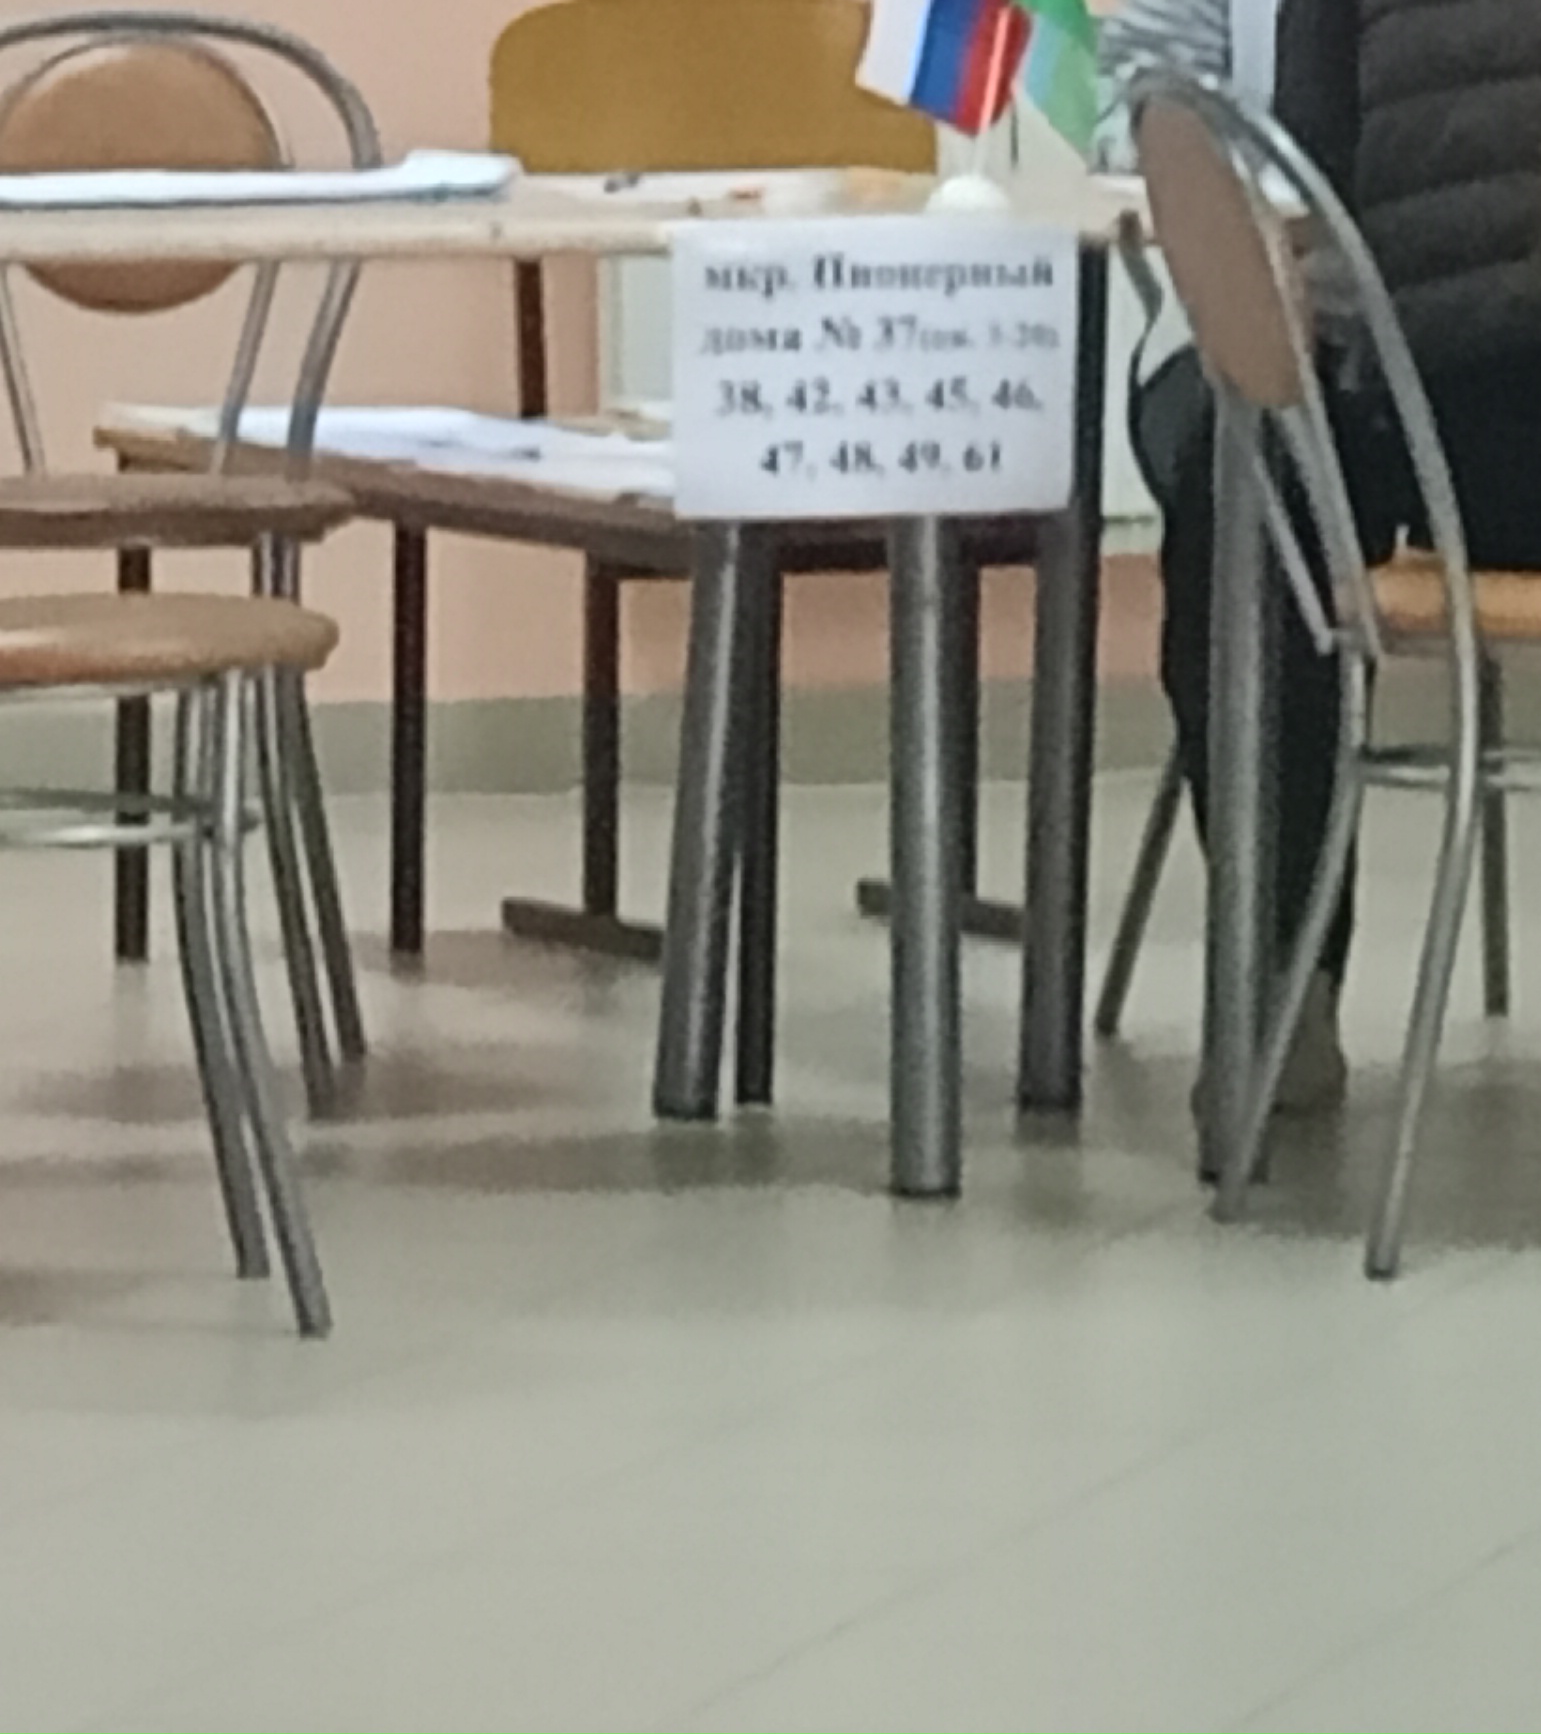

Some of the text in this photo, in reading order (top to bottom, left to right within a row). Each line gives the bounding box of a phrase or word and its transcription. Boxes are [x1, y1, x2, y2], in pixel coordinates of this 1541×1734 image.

[705, 253, 1054, 297] мкр. Пионерный
[701, 327, 802, 355] дома
[815, 315, 862, 351] №
